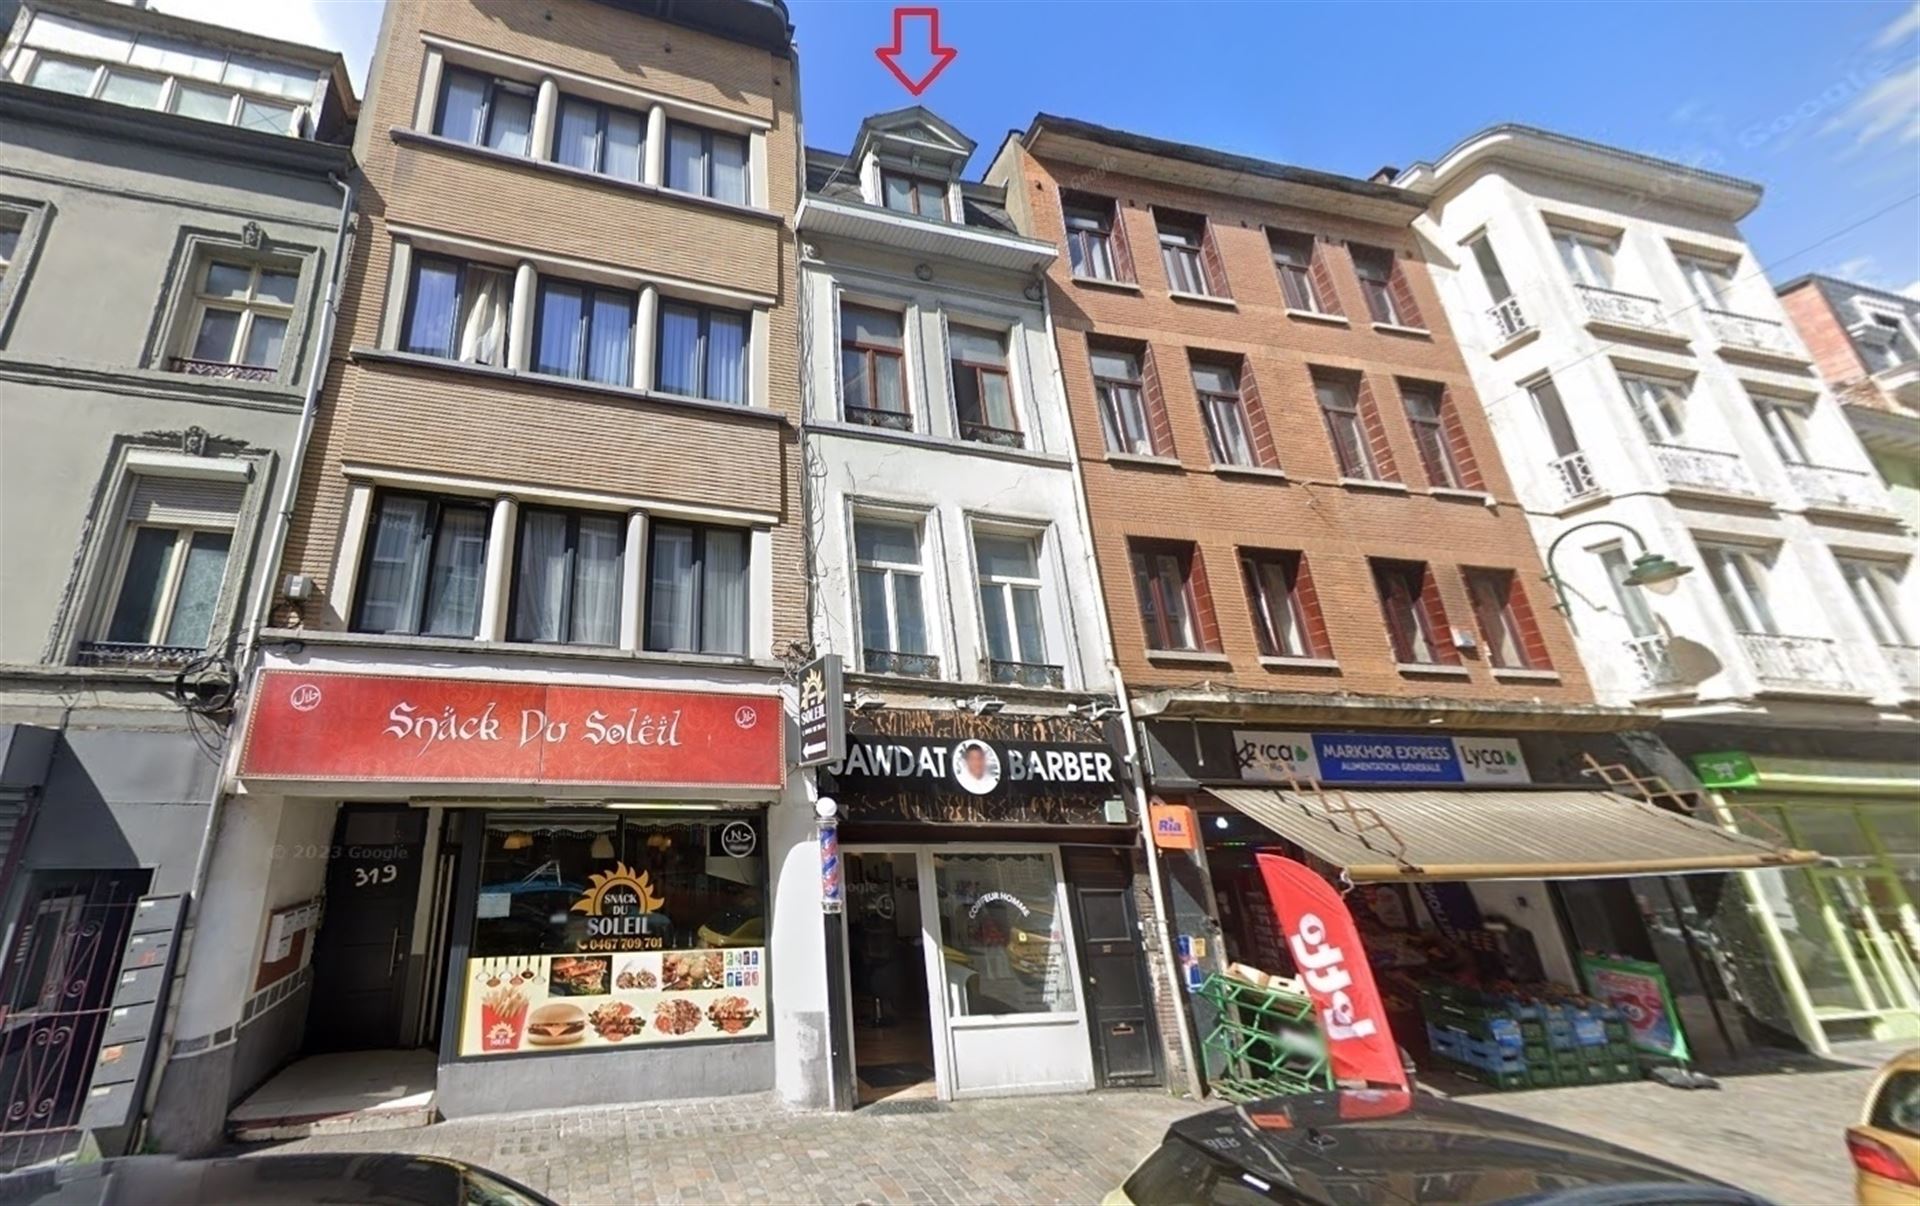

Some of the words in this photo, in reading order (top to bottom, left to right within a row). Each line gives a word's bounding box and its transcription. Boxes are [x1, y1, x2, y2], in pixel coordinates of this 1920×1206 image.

[1322, 744, 1394, 760] MARKHOR
[1396, 746, 1452, 761] EXPRESS
[1459, 744, 1505, 769] Lyca
[1007, 748, 1115, 783] BARBER
[1158, 816, 1182, 832] Ria
[354, 864, 398, 888] 319
[604, 893, 638, 904] SNACK
[612, 905, 629, 916] DU
[586, 916, 652, 936] SOLEIL
[589, 938, 618, 951] 0467
[620, 937, 642, 950] 709
[643, 936, 663, 949] 701
